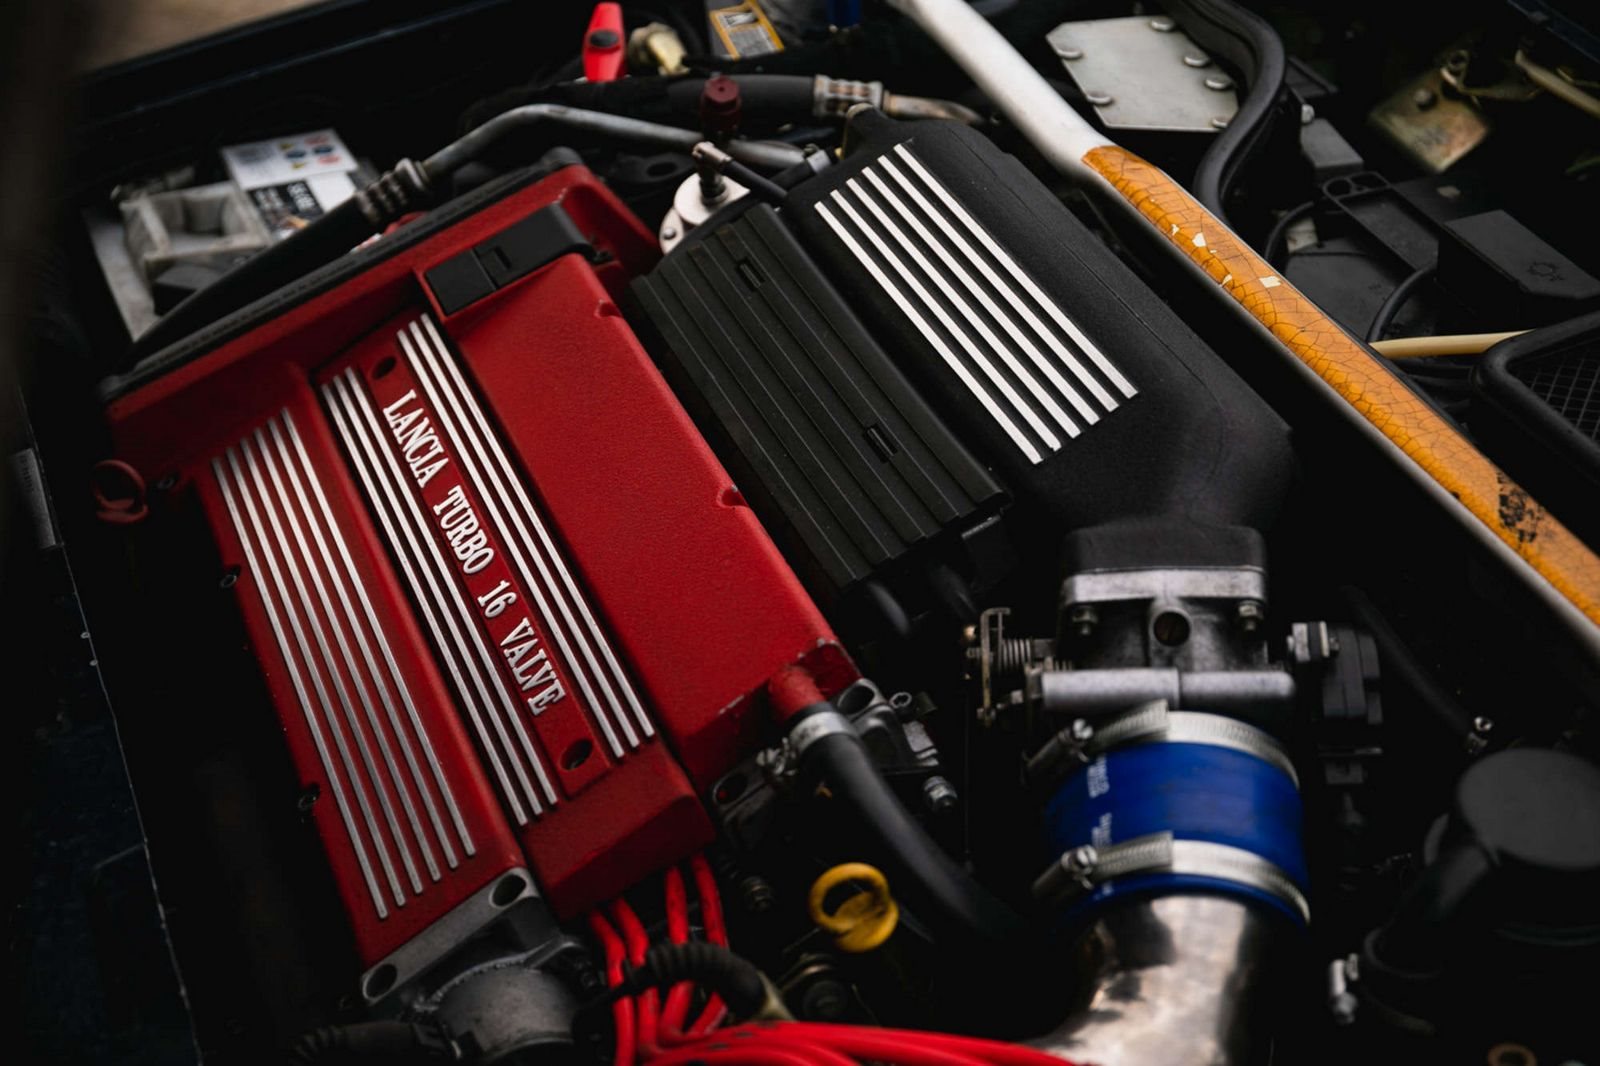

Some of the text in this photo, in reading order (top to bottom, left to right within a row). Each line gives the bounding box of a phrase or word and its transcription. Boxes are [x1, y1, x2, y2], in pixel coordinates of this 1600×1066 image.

[383, 389, 566, 716] LANCIA TURBO 16 VALVE
